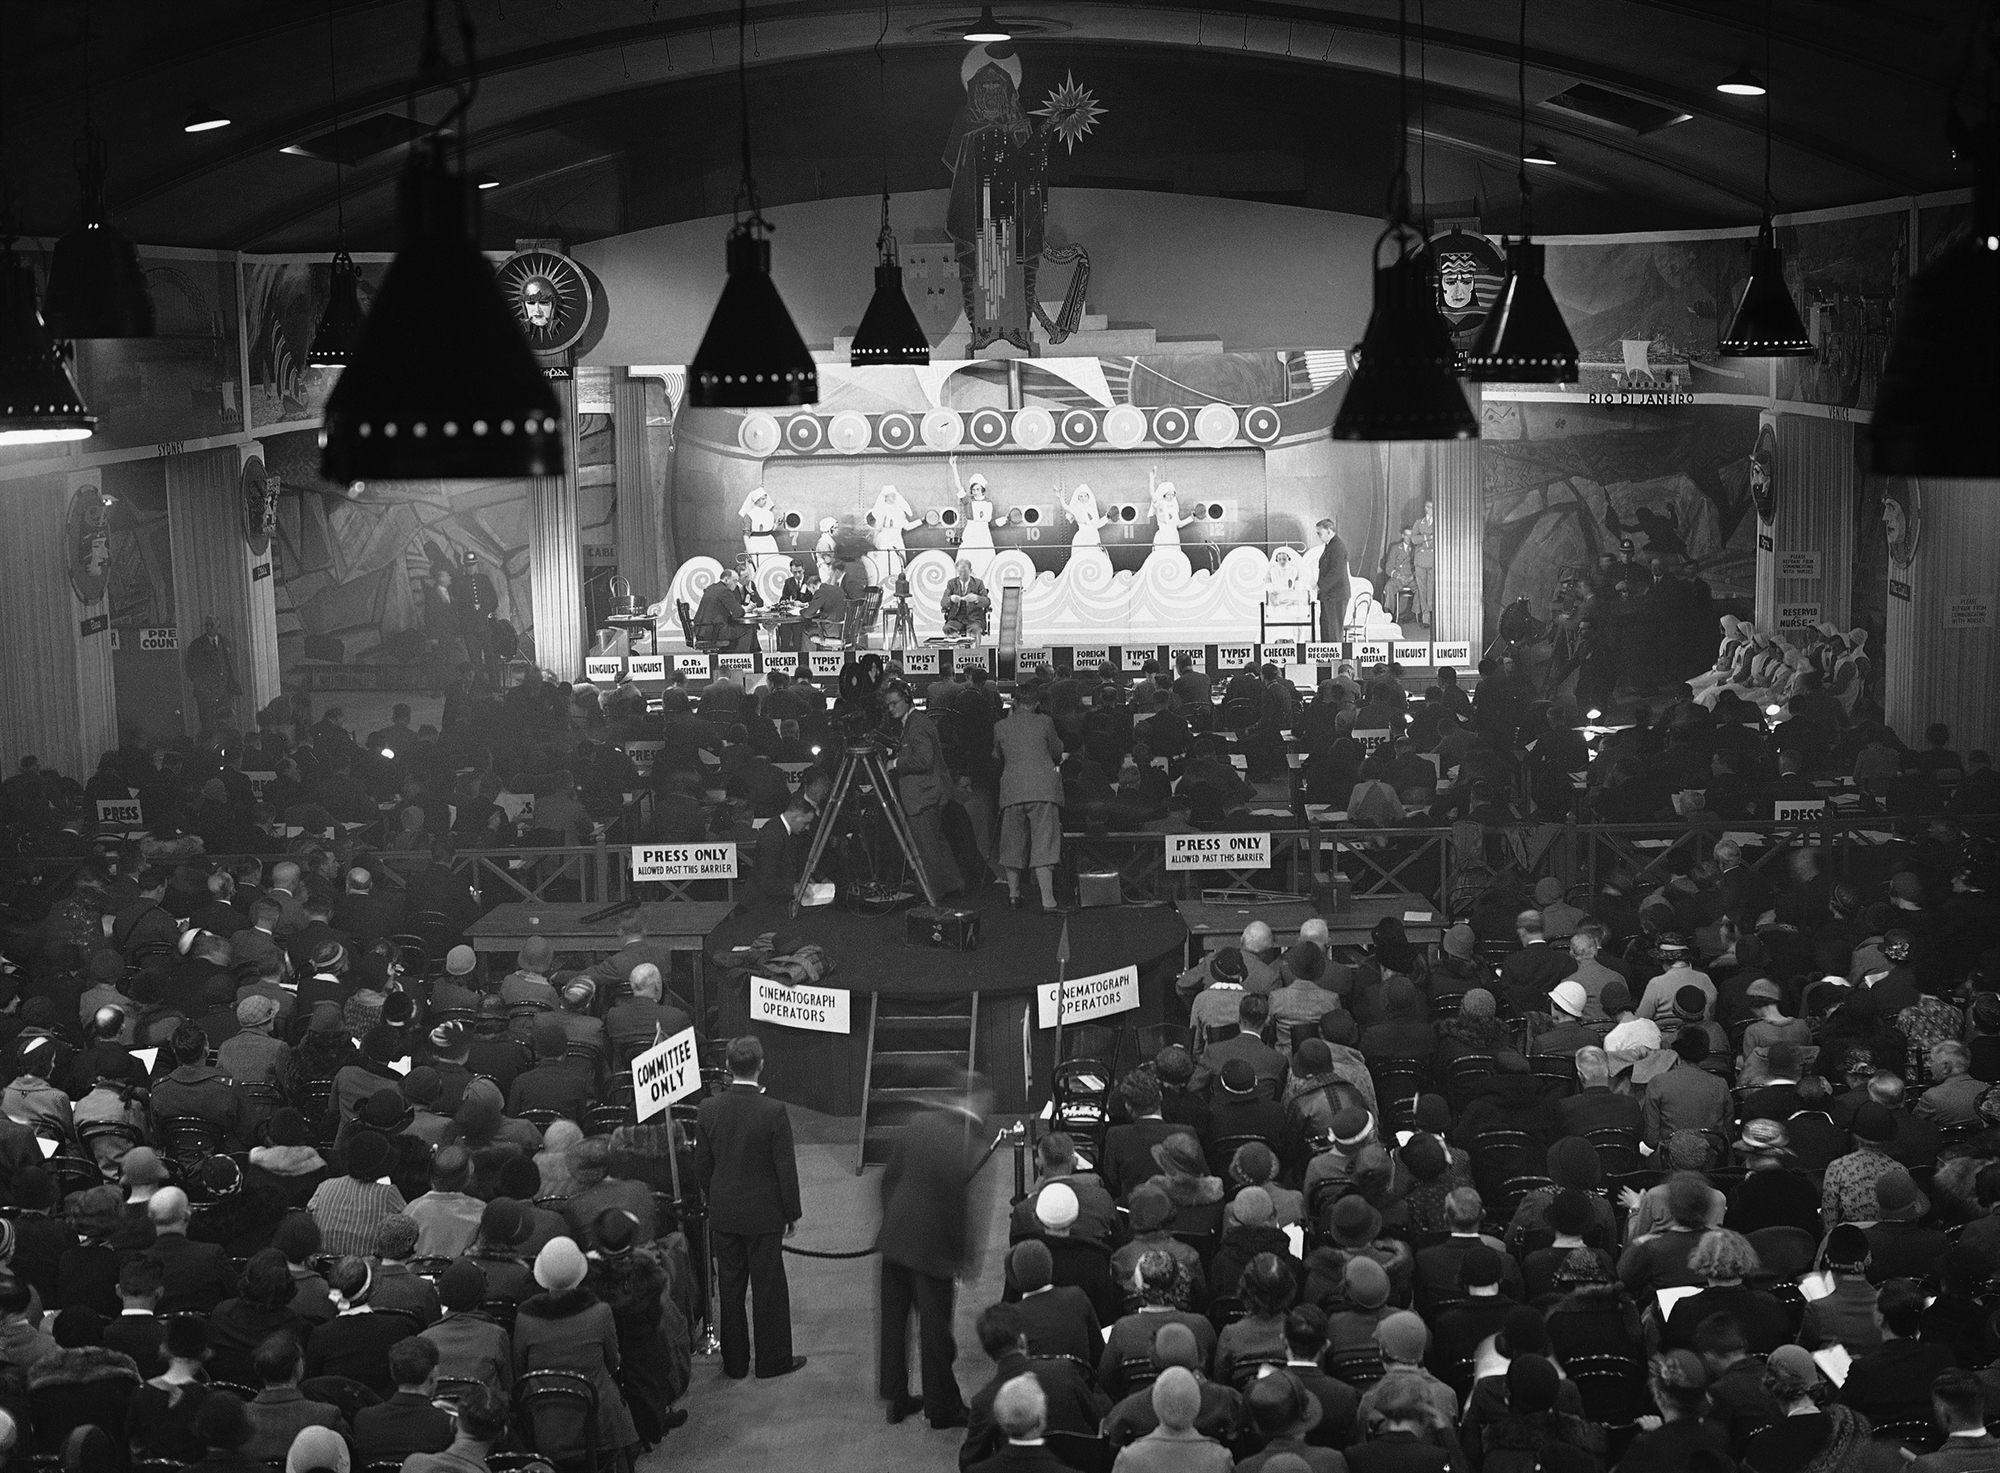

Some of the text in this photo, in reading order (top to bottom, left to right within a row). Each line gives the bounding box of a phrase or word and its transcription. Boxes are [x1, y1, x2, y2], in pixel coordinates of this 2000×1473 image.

[1589, 393, 1694, 405] RIO DI JANEIRO
[1828, 406, 1849, 421] VENICE
[158, 441, 185, 456] SYDNEY
[1026, 527, 1040, 541] 10
[1123, 525, 1134, 538] 11
[1210, 523, 1225, 536] 12
[789, 532, 798, 546] 7
[587, 547, 615, 557] CABL
[1783, 608, 1817, 616] RESERVED
[148, 630, 177, 638] PRE
[142, 639, 179, 648] COUNT
[1020, 652, 1046, 660] CHIEF
[1076, 650, 1106, 658] FOREIGN
[1126, 650, 1155, 660] TYPIST
[1220, 648, 1251, 659] TYPIST
[1263, 647, 1296, 657] CHECKER
[1395, 648, 1427, 658] LINGUIST
[1437, 648, 1467, 659] LINGUIST
[764, 656, 797, 667] CHECKER
[812, 657, 840, 665] TYPIST
[906, 655, 935, 663] TYPIST
[1076, 659, 1105, 667] OFFICIA
[588, 664, 619, 674] LINGUIST
[632, 663, 662, 673] LINGUIST
[102, 806, 140, 821] PRESS
[1780, 808, 1823, 820] PRESS
[1176, 837, 1262, 851] PRESS ONLY
[643, 848, 728, 863] PRESS ONLY
[1171, 853, 1265, 864] ALLOWED PAST THIS BARRIER
[637, 863, 732, 876] ALLOWED PAST THIS BARRIER
[1050, 974, 1130, 1001] CNEMATOGRAPH
[759, 985, 836, 1008] CINEMATOGRAPH
[763, 1002, 826, 1023] OPERATORS
[637, 1040, 691, 1087] COMMITTEE
[651, 1066, 684, 1102] ONLY
